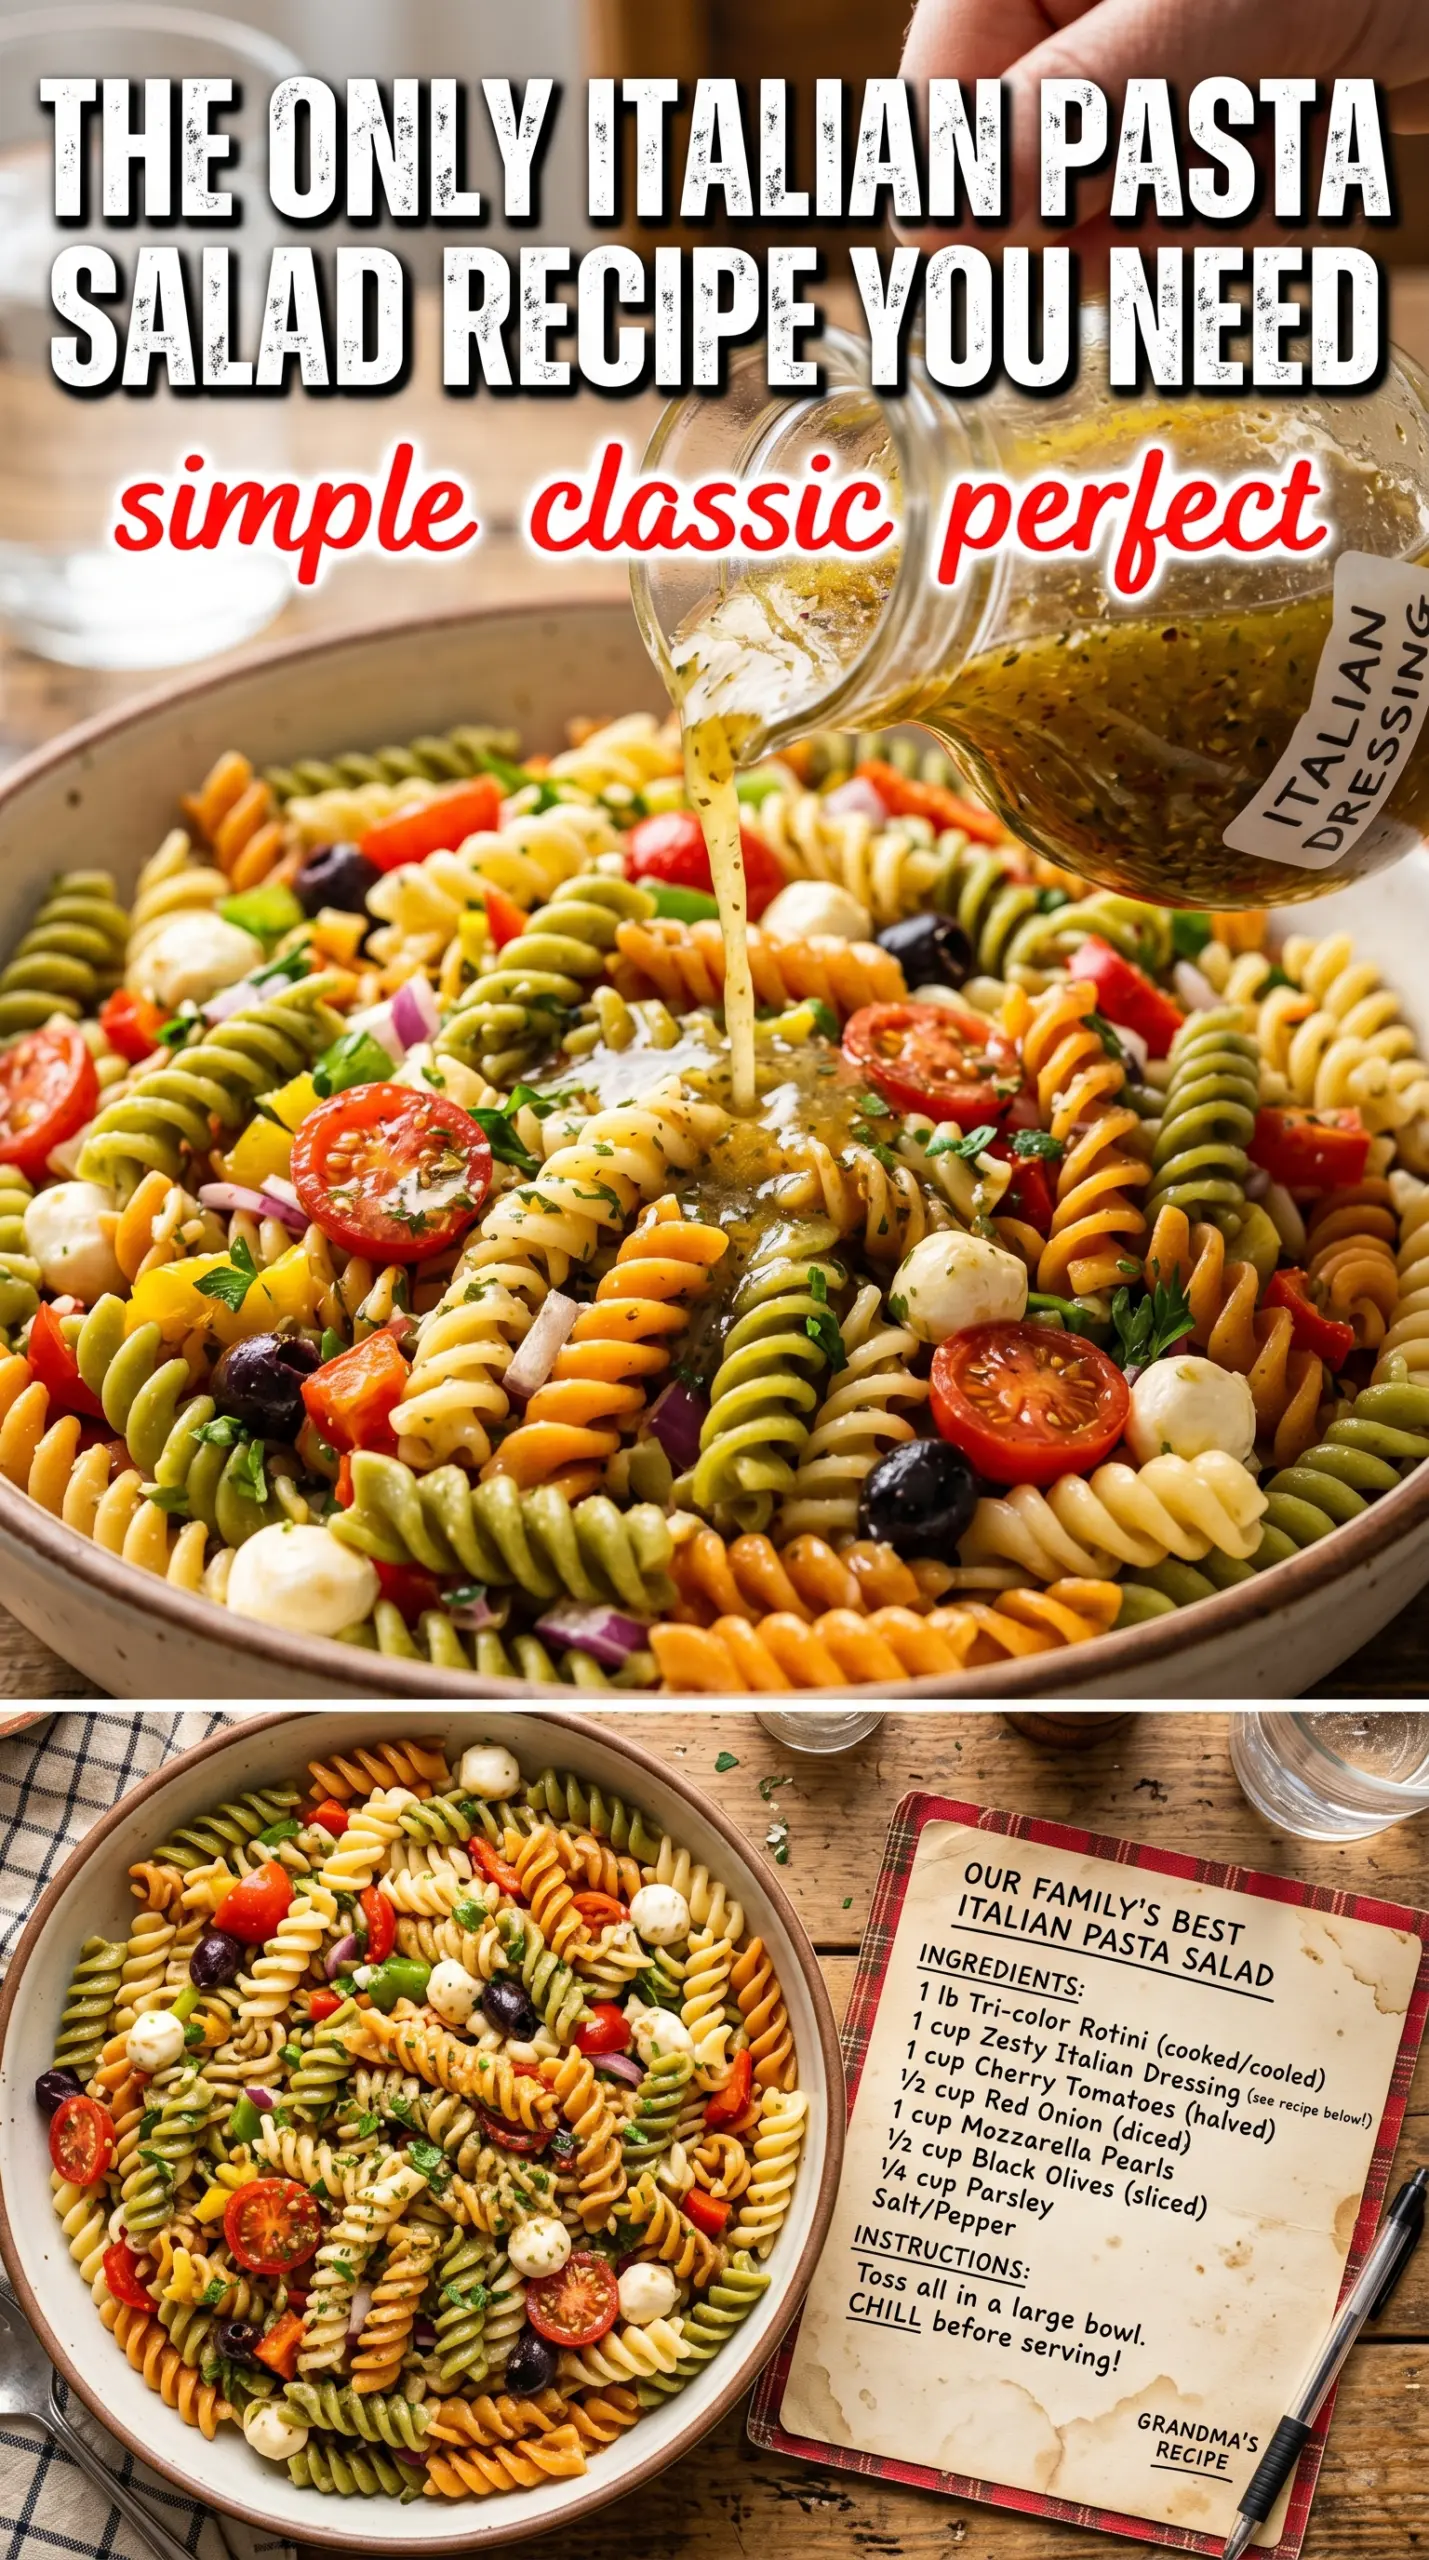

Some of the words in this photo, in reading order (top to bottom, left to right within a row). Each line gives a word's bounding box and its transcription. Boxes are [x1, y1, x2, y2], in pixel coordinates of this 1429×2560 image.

[1262, 605, 1387, 828] ITALIAN
[1301, 594, 1429, 852] DRESSING
[958, 1893, 1073, 1941] ITALIAN
[1082, 1922, 1169, 1965] PASTA
[1181, 1946, 1274, 1987] SALAD
[963, 1861, 1022, 1895] OUR
[1032, 1877, 1161, 1927] FAMILY'S
[1171, 1909, 1246, 1946] BEST
[919, 1943, 1085, 1997] INGREDIENTS:
[913, 2010, 922, 2031] 1
[930, 2021, 971, 2047] cup
[979, 2026, 1048, 2064] Zesty
[1054, 2042, 1133, 2078] Italian
[1143, 2062, 1241, 2109] Dressing
[1247, 2087, 1275, 2107] (see
[1279, 2100, 1319, 2118] recipe
[1323, 2106, 1373, 2130] below!)
[920, 1981, 929, 2002] 1
[938, 1984, 959, 2008] lb
[969, 1992, 1071, 2032] Tri-color
[1079, 2016, 1147, 2051] Rotini
[1157, 2033, 1326, 2093] (cooked/cooled)
[907, 2039, 916, 2060] 1
[924, 2050, 965, 2076] cup
[975, 2056, 1057, 2097] Cherry
[1066, 2075, 1176, 2119] Tomatoes
[1185, 2100, 1276, 2145] (halved)
[935, 2084, 975, 2110] cup
[984, 2088, 1030, 2117] Red
[1038, 2101, 1102, 2133] Onion
[1113, 2114, 1191, 2156] (diced)
[893, 2098, 903, 2119] 1
[911, 2109, 952, 2135] cup
[960, 2114, 1091, 2162] Mozzarella
[1101, 2145, 1175, 2180] Pearls
[872, 2187, 1017, 2237] Salt/Pepper
[916, 2172, 957, 2198] cup
[966, 2176, 1055, 2221] Parsley
[922, 2143, 962, 2169] cup
[972, 2146, 1036, 2180] Black
[1045, 2165, 1115, 2198] Olives
[1124, 2179, 1207, 2222] (sliced)
[854, 2224, 1030, 2280] INSTRUCTIONS:
[848, 2292, 922, 2327] CHILL
[932, 2309, 1012, 2348] before
[1020, 2337, 1122, 2377] serving!
[857, 2261, 908, 2292] Toss
[916, 2277, 948, 2301] all
[956, 2284, 977, 2308] in
[987, 2298, 1002, 2314] a
[1012, 2296, 1075, 2333] large
[1084, 2311, 1145, 2346] bowl.
[1137, 2412, 1259, 2453] GRANDMA'S
[1156, 2440, 1230, 2470] RECIPE
